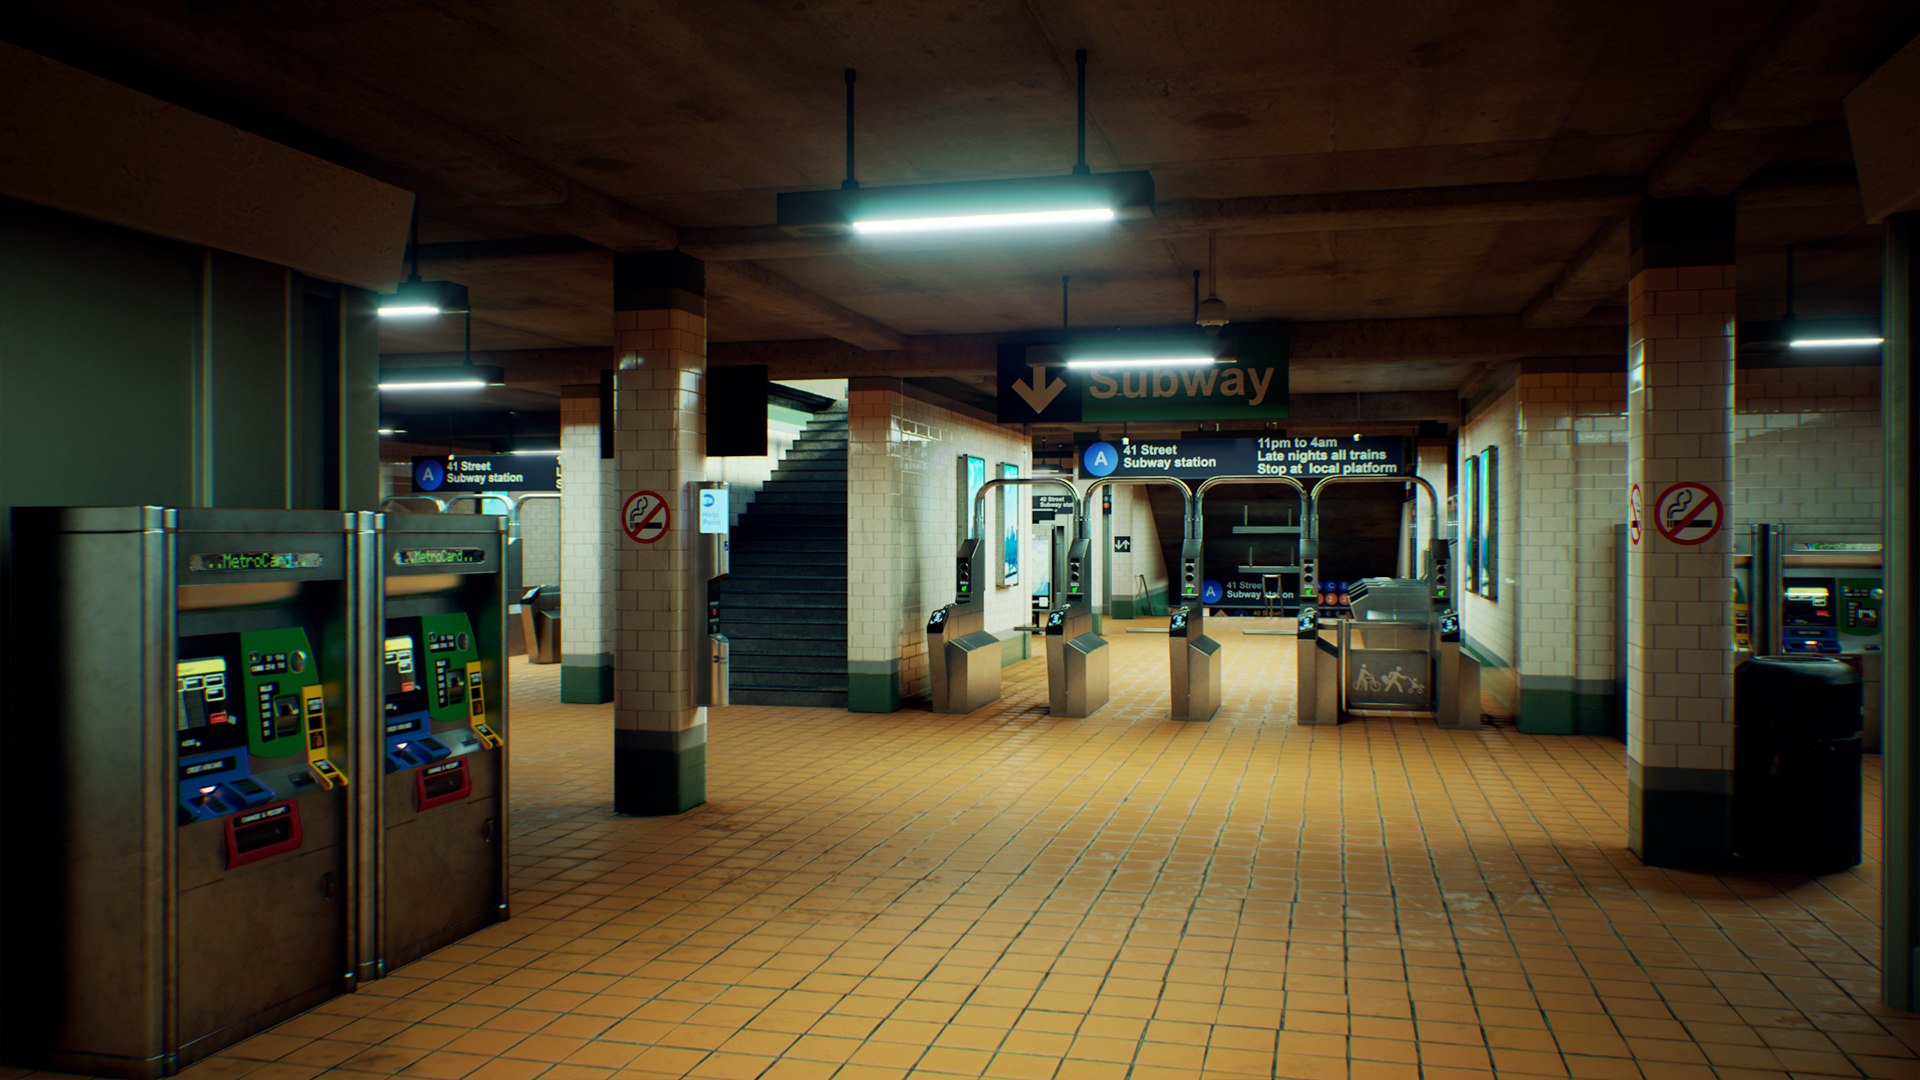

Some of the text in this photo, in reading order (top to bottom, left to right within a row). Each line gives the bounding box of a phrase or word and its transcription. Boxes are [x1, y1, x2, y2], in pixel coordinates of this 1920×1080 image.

[1089, 365, 1276, 406] Subway
[1123, 444, 1177, 455] 41 Street
[1257, 436, 1338, 451] 11pm to 4am
[1094, 450, 1108, 466] A
[1123, 456, 1217, 470] Subway station
[1257, 448, 1387, 464] Late nights all trains
[446, 460, 491, 471] 41 Street
[1257, 462, 1398, 476] Stop at local platform
[422, 467, 435, 481] A
[446, 471, 524, 485] Subway station
[1205, 586, 1216, 597] A
[1226, 581, 1263, 589] 41 Stree
[1226, 590, 1261, 600] Subway
